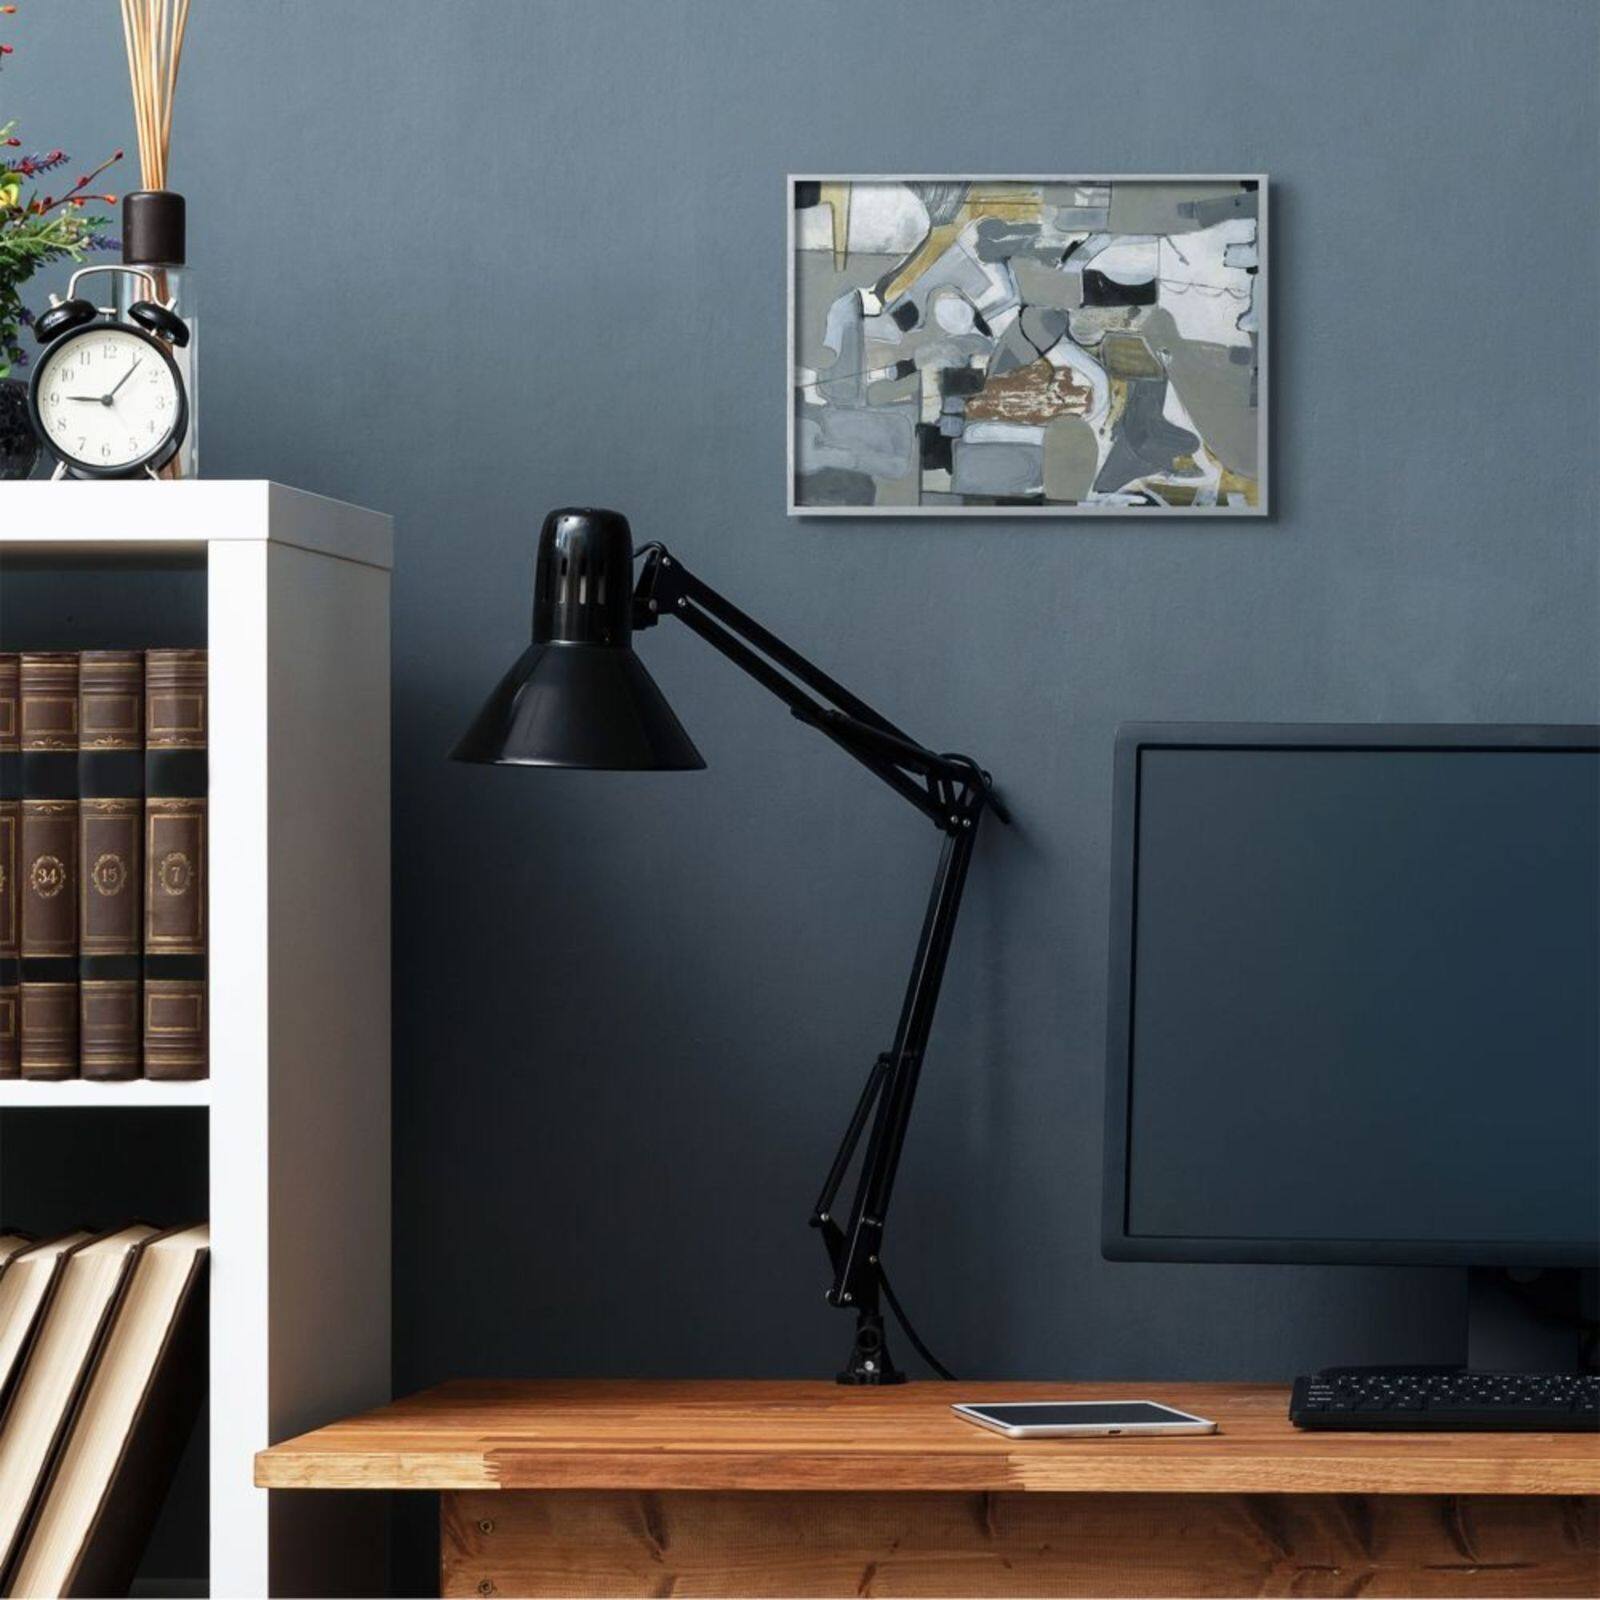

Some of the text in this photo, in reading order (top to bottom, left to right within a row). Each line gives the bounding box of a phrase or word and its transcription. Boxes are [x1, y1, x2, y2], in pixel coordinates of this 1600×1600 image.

[104, 345, 118, 359] 12
[81, 352, 91, 366] 11
[62, 369, 74, 382] 10
[150, 370, 158, 383] 2
[50, 393, 59, 406] 9
[156, 396, 165, 409] 3
[57, 418, 68, 431] 8
[78, 437, 86, 450] 7
[101, 443, 111, 457] 6
[130, 438, 138, 451] 5
[38, 869, 56, 883] 34
[102, 869, 117, 882] 15
[172, 867, 180, 882] 7
